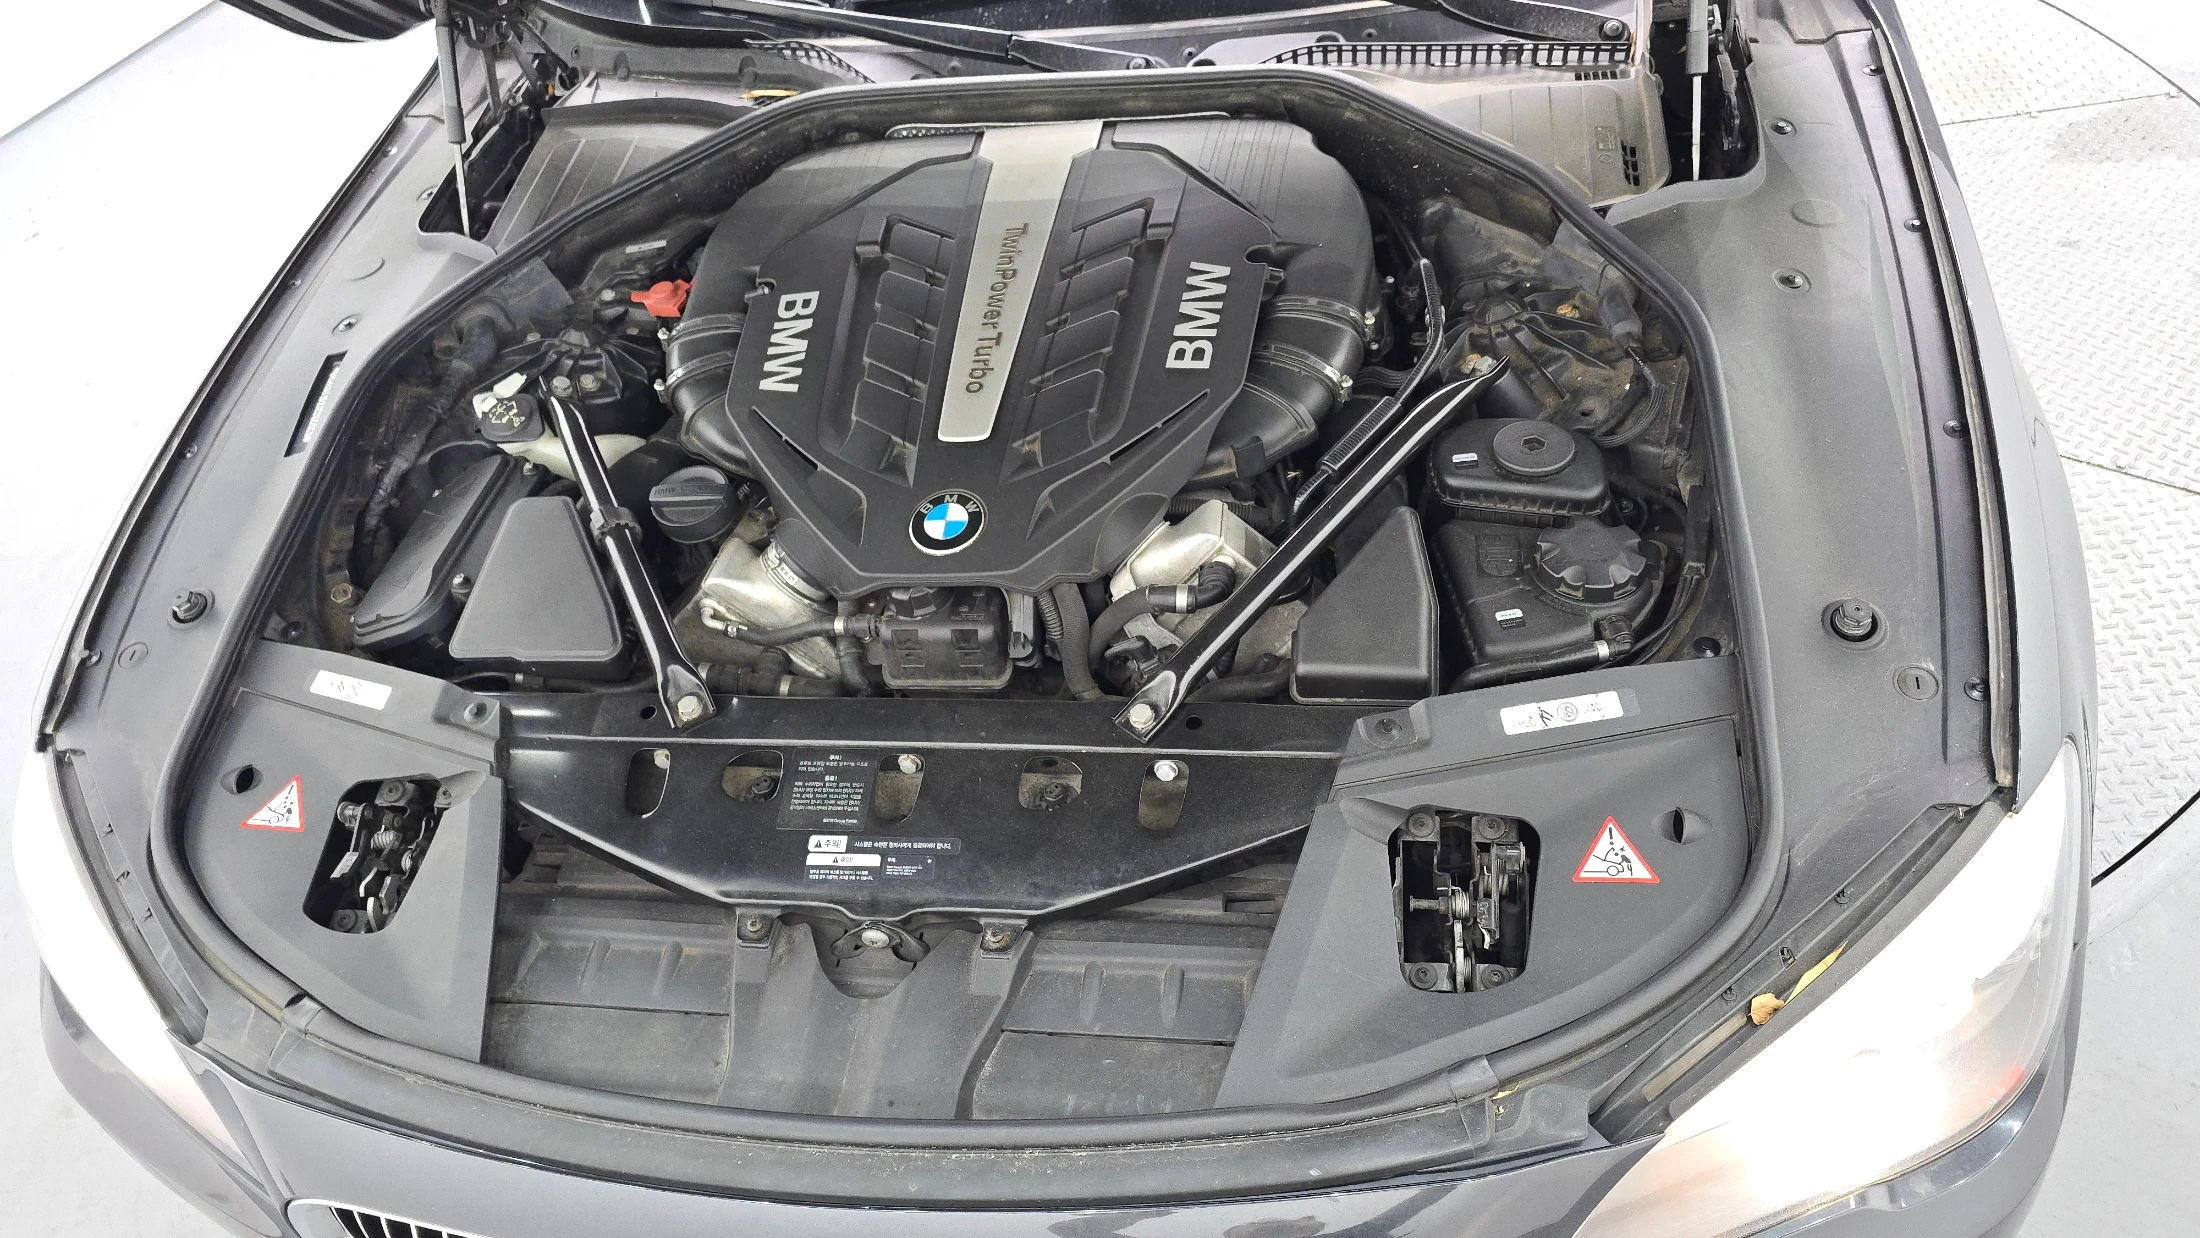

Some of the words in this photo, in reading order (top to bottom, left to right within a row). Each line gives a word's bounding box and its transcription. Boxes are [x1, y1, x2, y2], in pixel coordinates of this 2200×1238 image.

[981, 222, 1029, 329] TwinPower
[1165, 261, 1231, 369] BMW
[759, 290, 820, 393] BMW
[965, 332, 1003, 394] Turbo
[919, 494, 980, 514] BMW
[824, 839, 842, 848] 주의!
